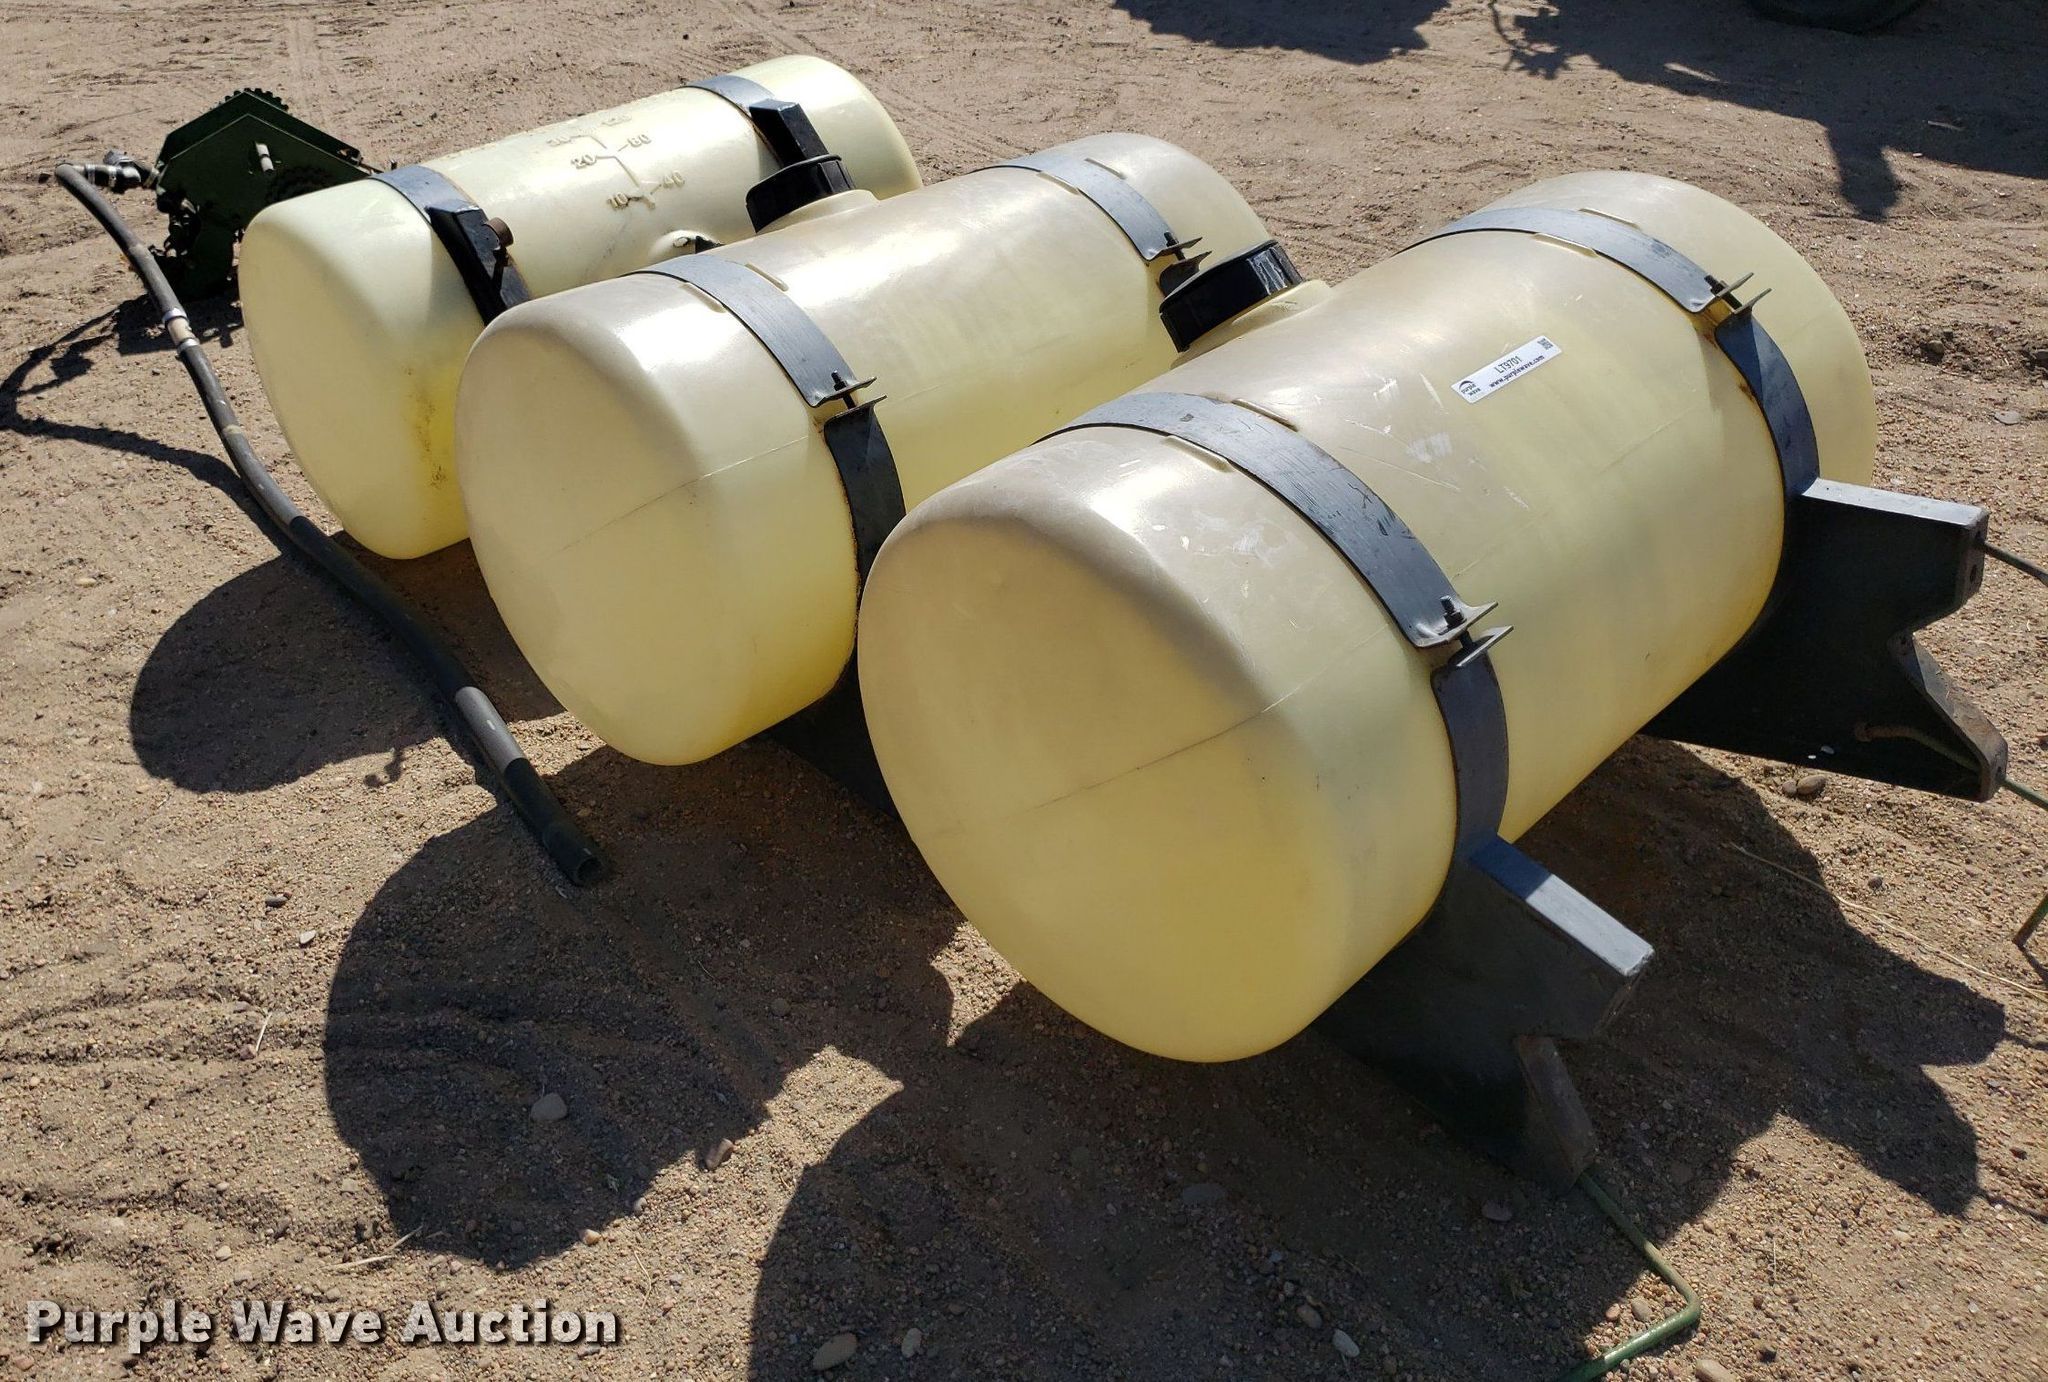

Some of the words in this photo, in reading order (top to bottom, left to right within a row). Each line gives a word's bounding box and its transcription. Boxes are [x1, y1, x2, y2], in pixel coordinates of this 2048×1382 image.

[570, 154, 597, 169] 20
[662, 172, 686, 189] 40
[607, 192, 629, 211] 10
[1489, 354, 1545, 388] www.purplewave.com
[1494, 355, 1524, 374] LT9701
